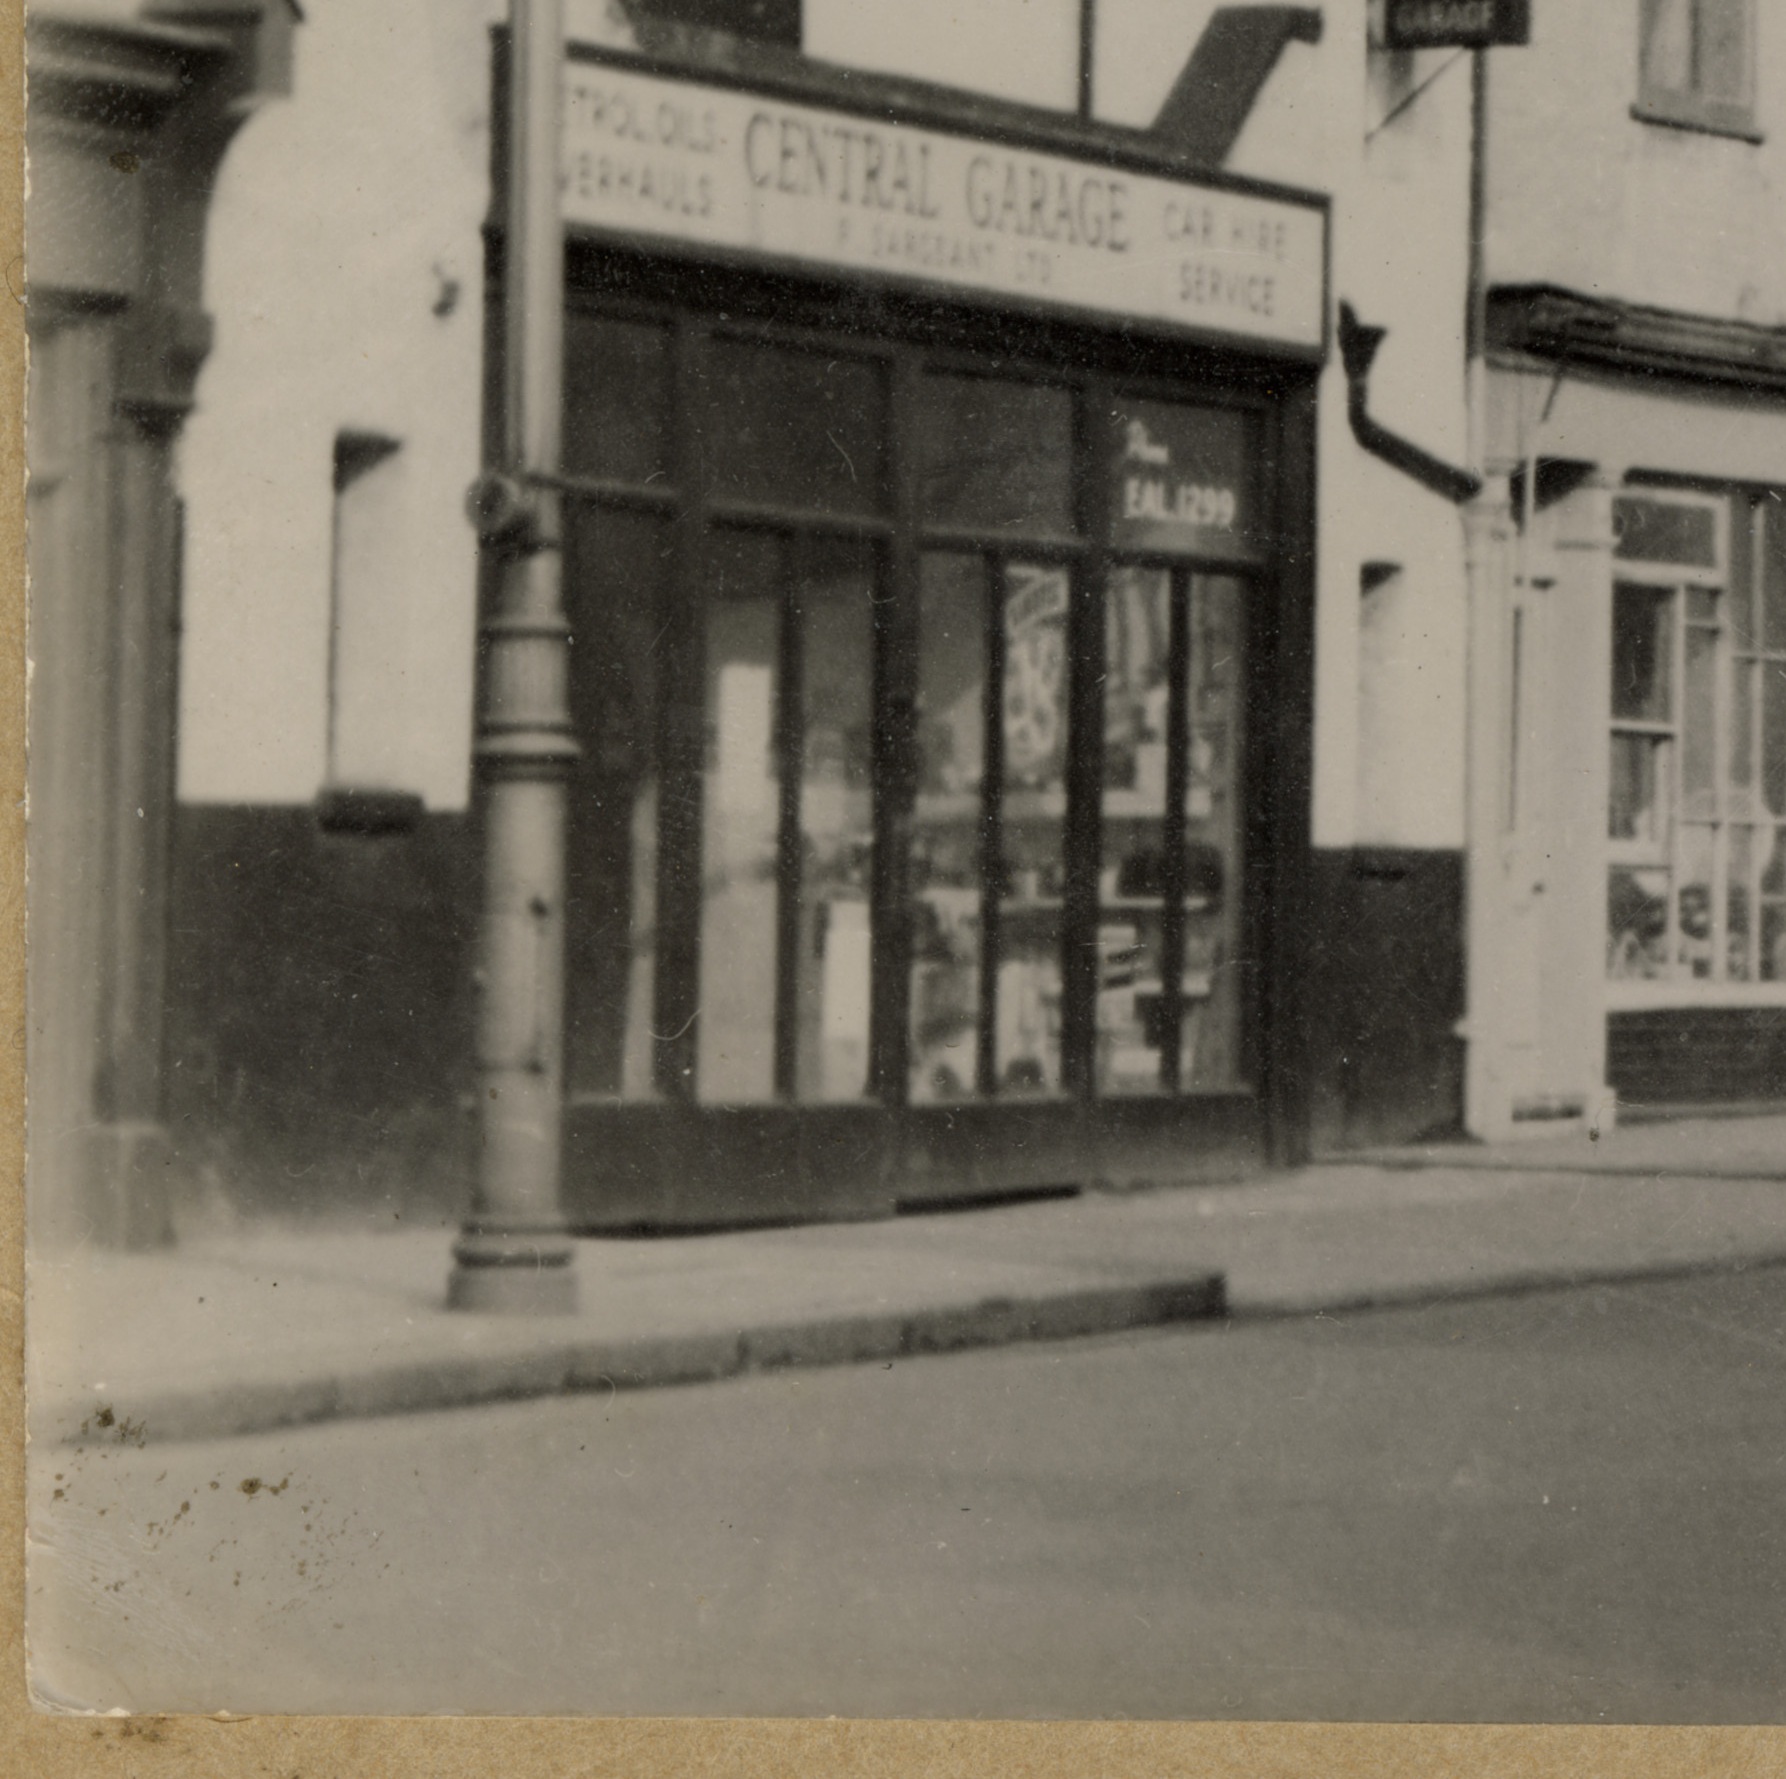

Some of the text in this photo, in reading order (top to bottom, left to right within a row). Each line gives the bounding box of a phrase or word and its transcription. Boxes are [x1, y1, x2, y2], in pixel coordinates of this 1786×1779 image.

[744, 111, 940, 219] CENTRAL
[966, 154, 1130, 252] GARAGE
[1163, 199, 1213, 248] CAR
[1178, 258, 1274, 318] SERVICE
